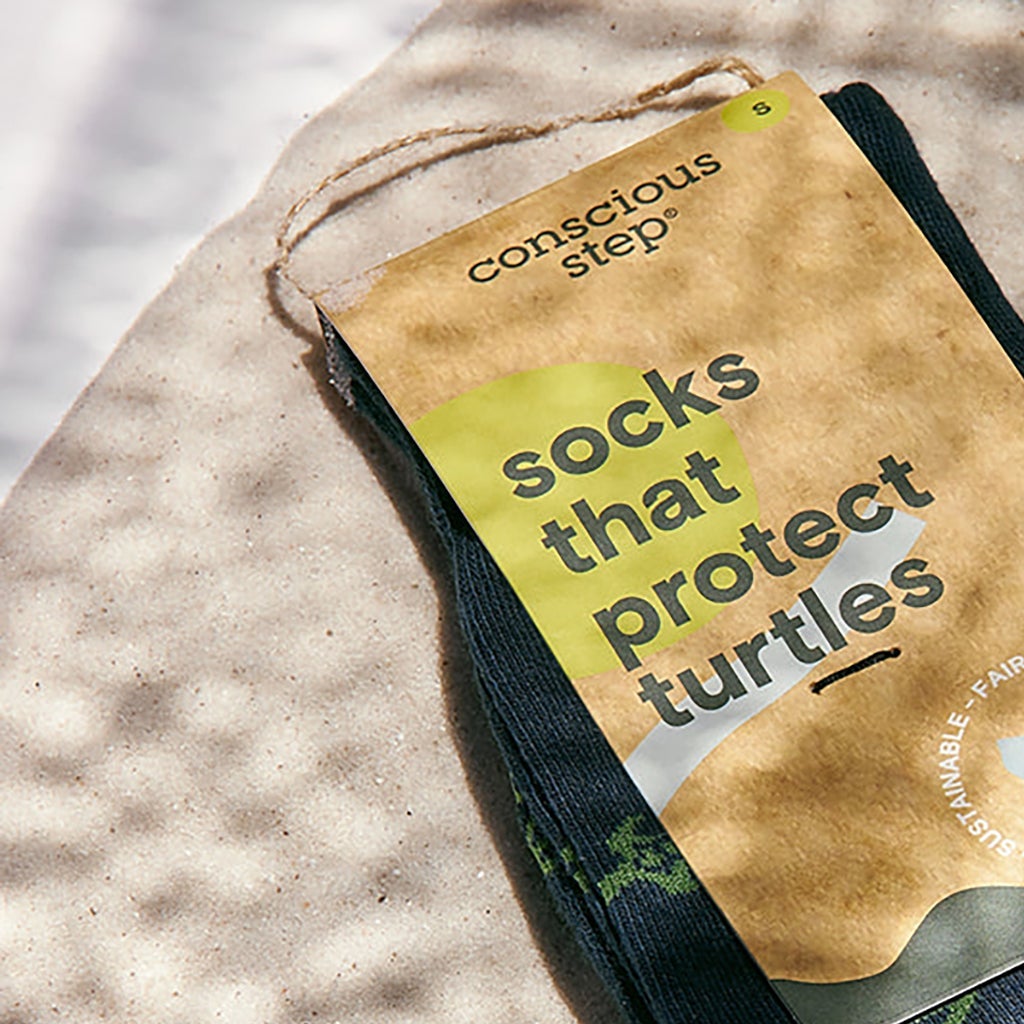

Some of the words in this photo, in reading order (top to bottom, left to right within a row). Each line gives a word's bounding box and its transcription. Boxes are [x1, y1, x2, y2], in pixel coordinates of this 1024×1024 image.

[468, 152, 722, 282] conscious
[502, 353, 760, 498] socks
[541, 451, 741, 573] that
[592, 455, 936, 672] protect
[637, 557, 945, 727] turtles
[939, 712, 1016, 858] SUSTAINABLE
